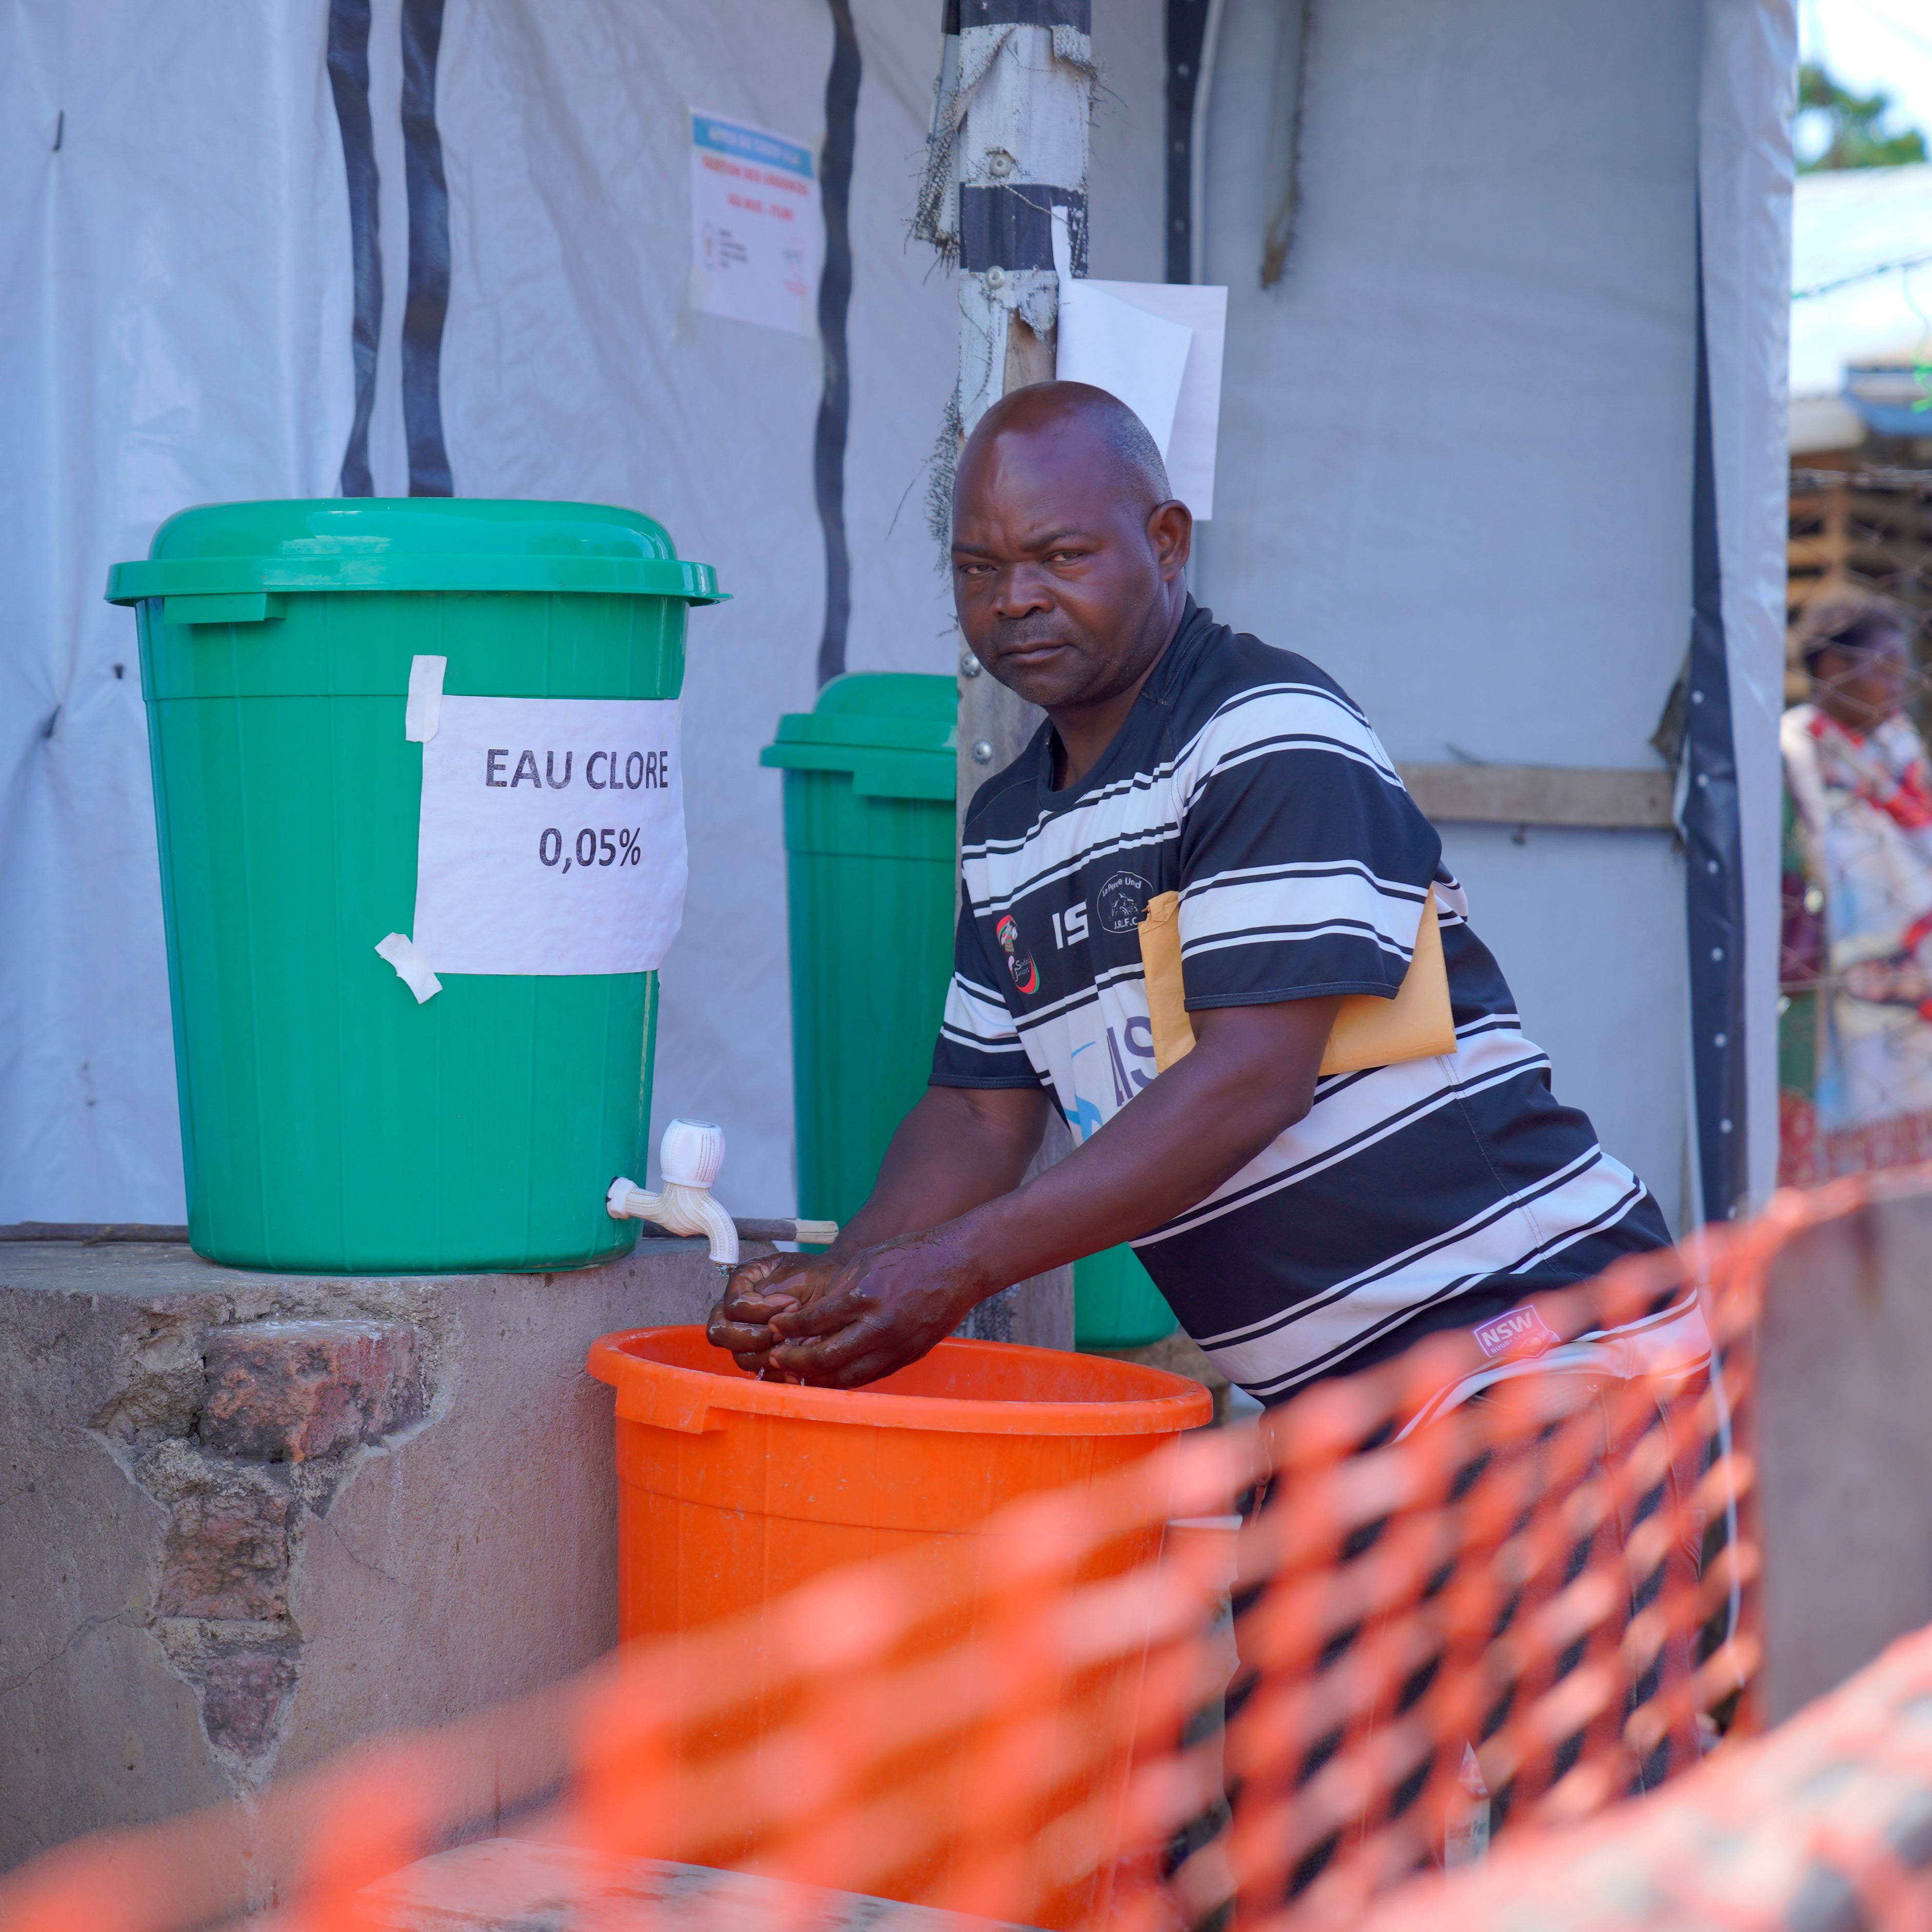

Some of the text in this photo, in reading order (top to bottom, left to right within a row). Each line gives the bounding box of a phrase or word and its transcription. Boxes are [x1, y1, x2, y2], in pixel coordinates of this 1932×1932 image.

[486, 748, 668, 790] EAU CLORE
[539, 827, 641, 874] 0,05%
[1102, 888, 1108, 897] La
[1481, 1311, 1532, 1347] NSW
[1490, 1338, 1513, 1354] RUGBY
